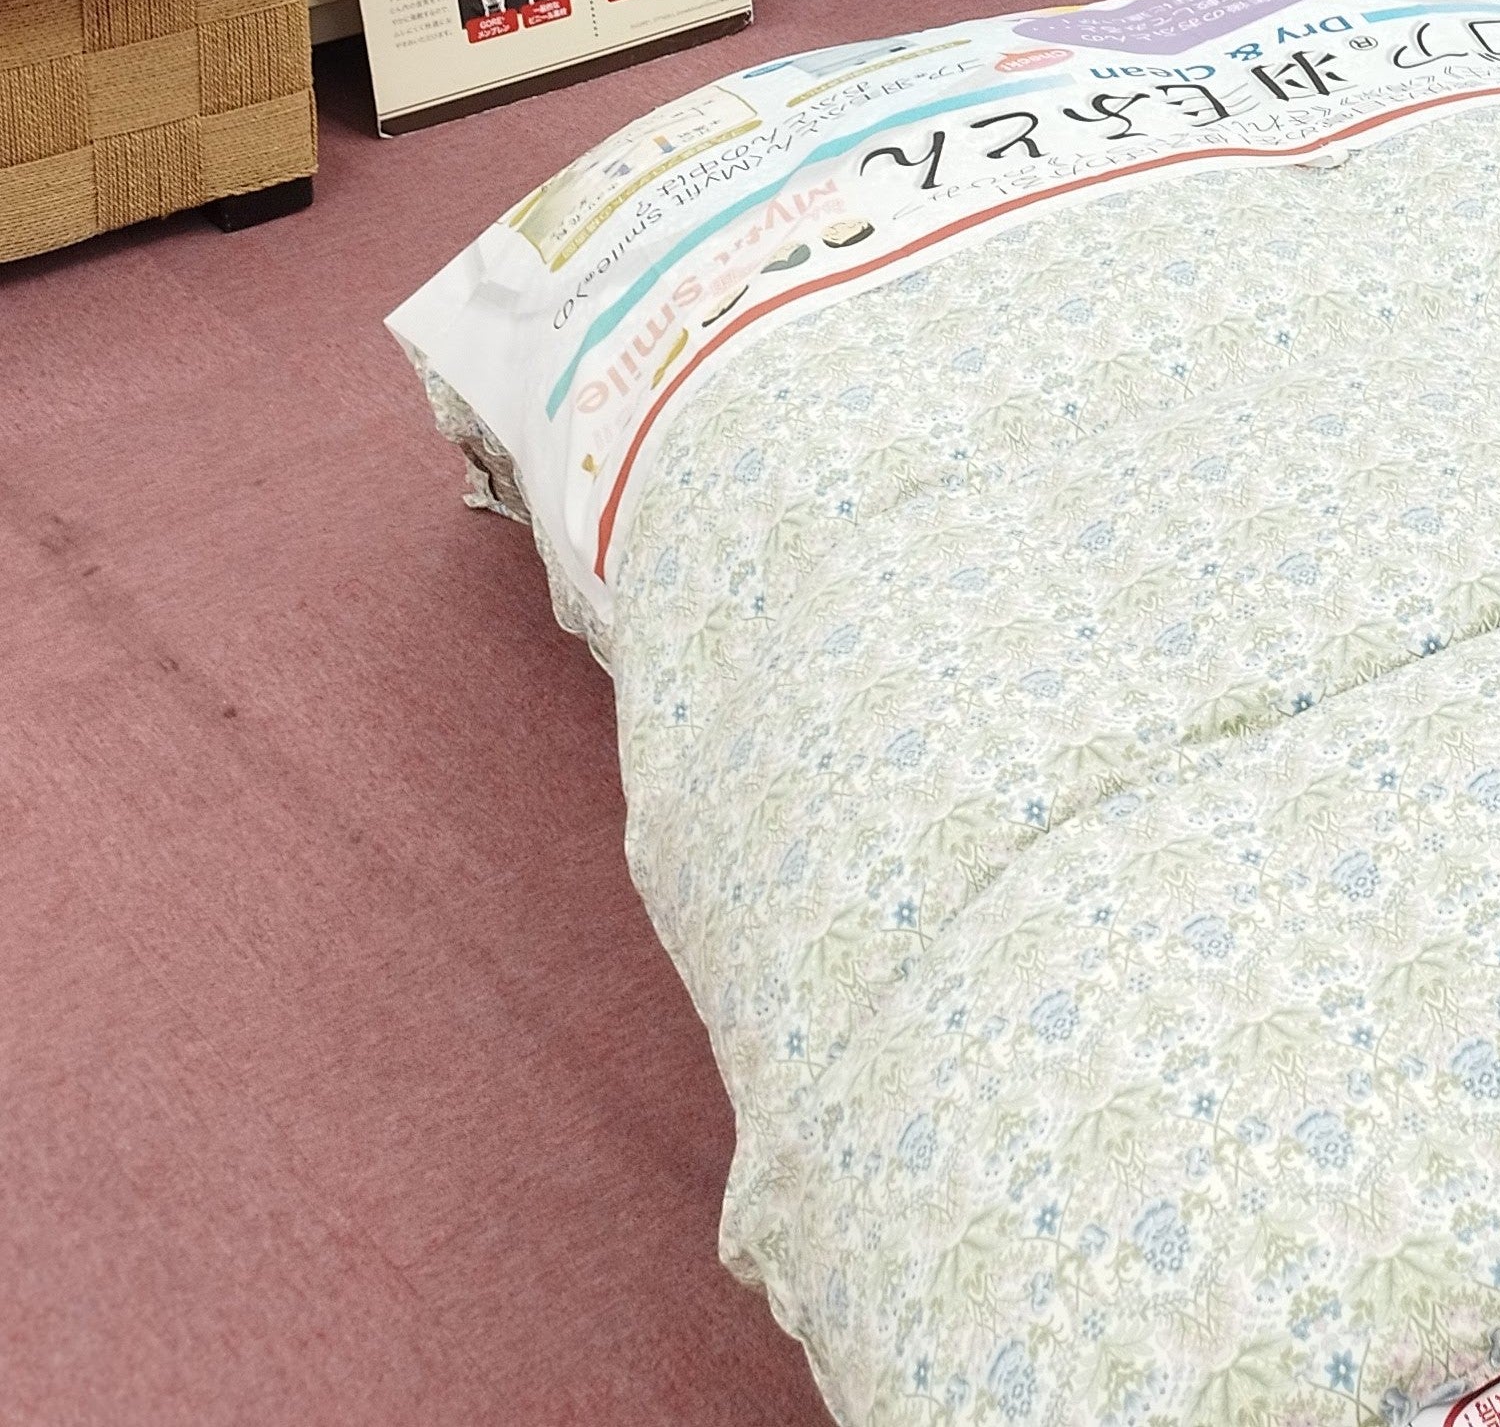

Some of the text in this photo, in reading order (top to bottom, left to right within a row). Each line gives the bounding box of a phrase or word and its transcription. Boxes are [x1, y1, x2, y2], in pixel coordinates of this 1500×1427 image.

[1089, 12, 1355, 84] Dry & Clean
[575, 278, 704, 416] smile
